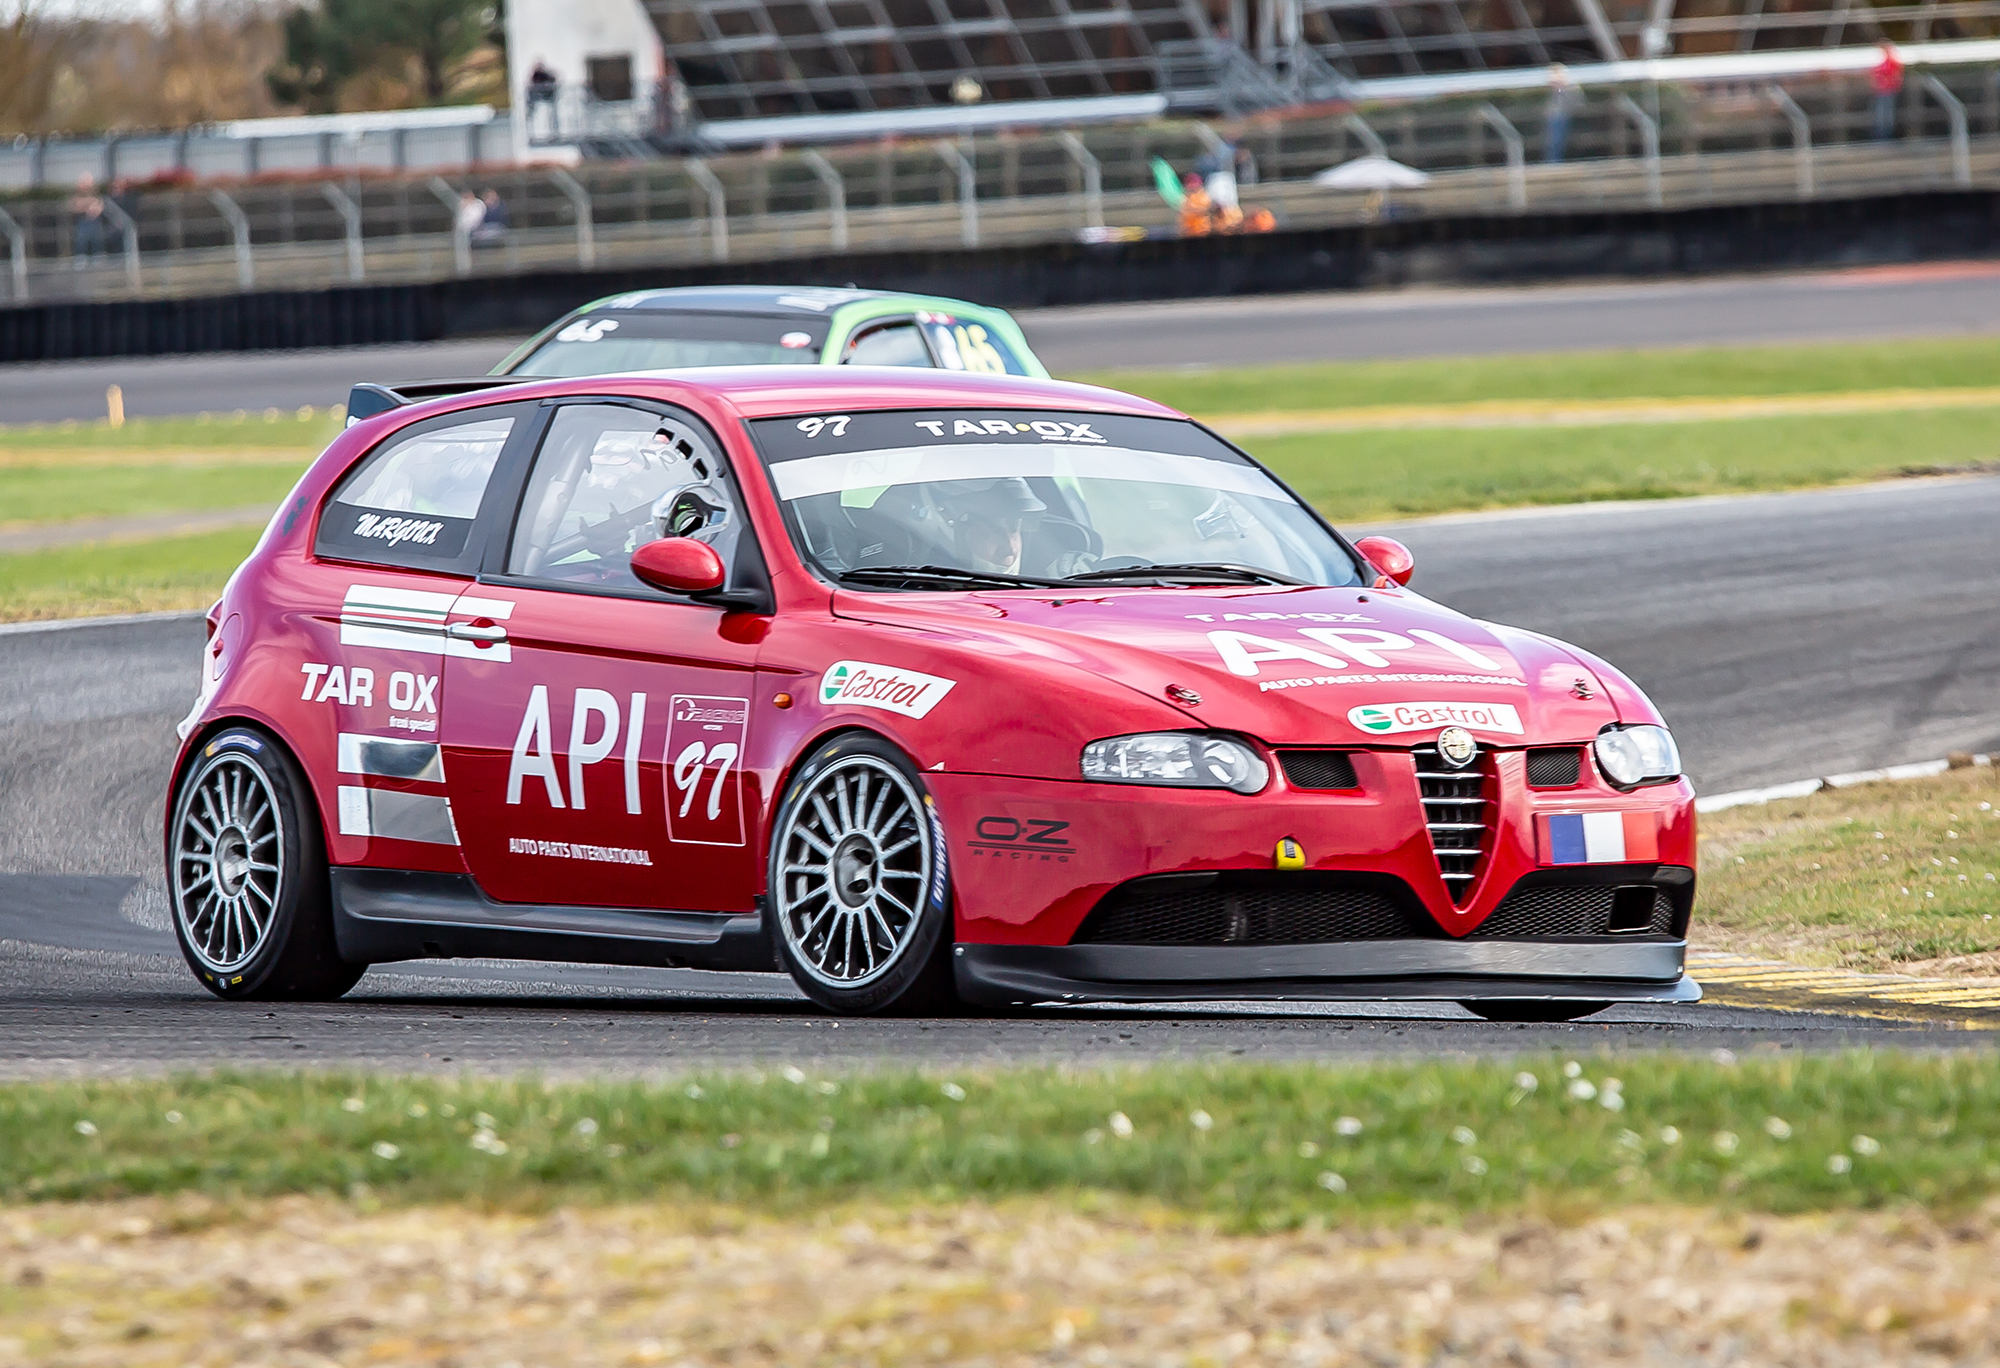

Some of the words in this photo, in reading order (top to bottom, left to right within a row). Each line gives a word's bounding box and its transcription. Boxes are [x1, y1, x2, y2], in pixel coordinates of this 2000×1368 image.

[796, 415, 852, 438] 97
[1206, 627, 1502, 676] API
[842, 669, 932, 707] Castrol
[1258, 676, 1314, 693] AUTO
[1312, 674, 1378, 686] PARTS
[1375, 673, 1528, 687] INTERNATIONAL
[1394, 706, 1502, 727] Castrol
[506, 685, 647, 814] API
[673, 741, 738, 821] 97
[509, 838, 537, 855] AUTO
[537, 840, 571, 858] PARTS
[569, 844, 653, 866] INTERNATIONAL
[973, 849, 1069, 862] RACING
